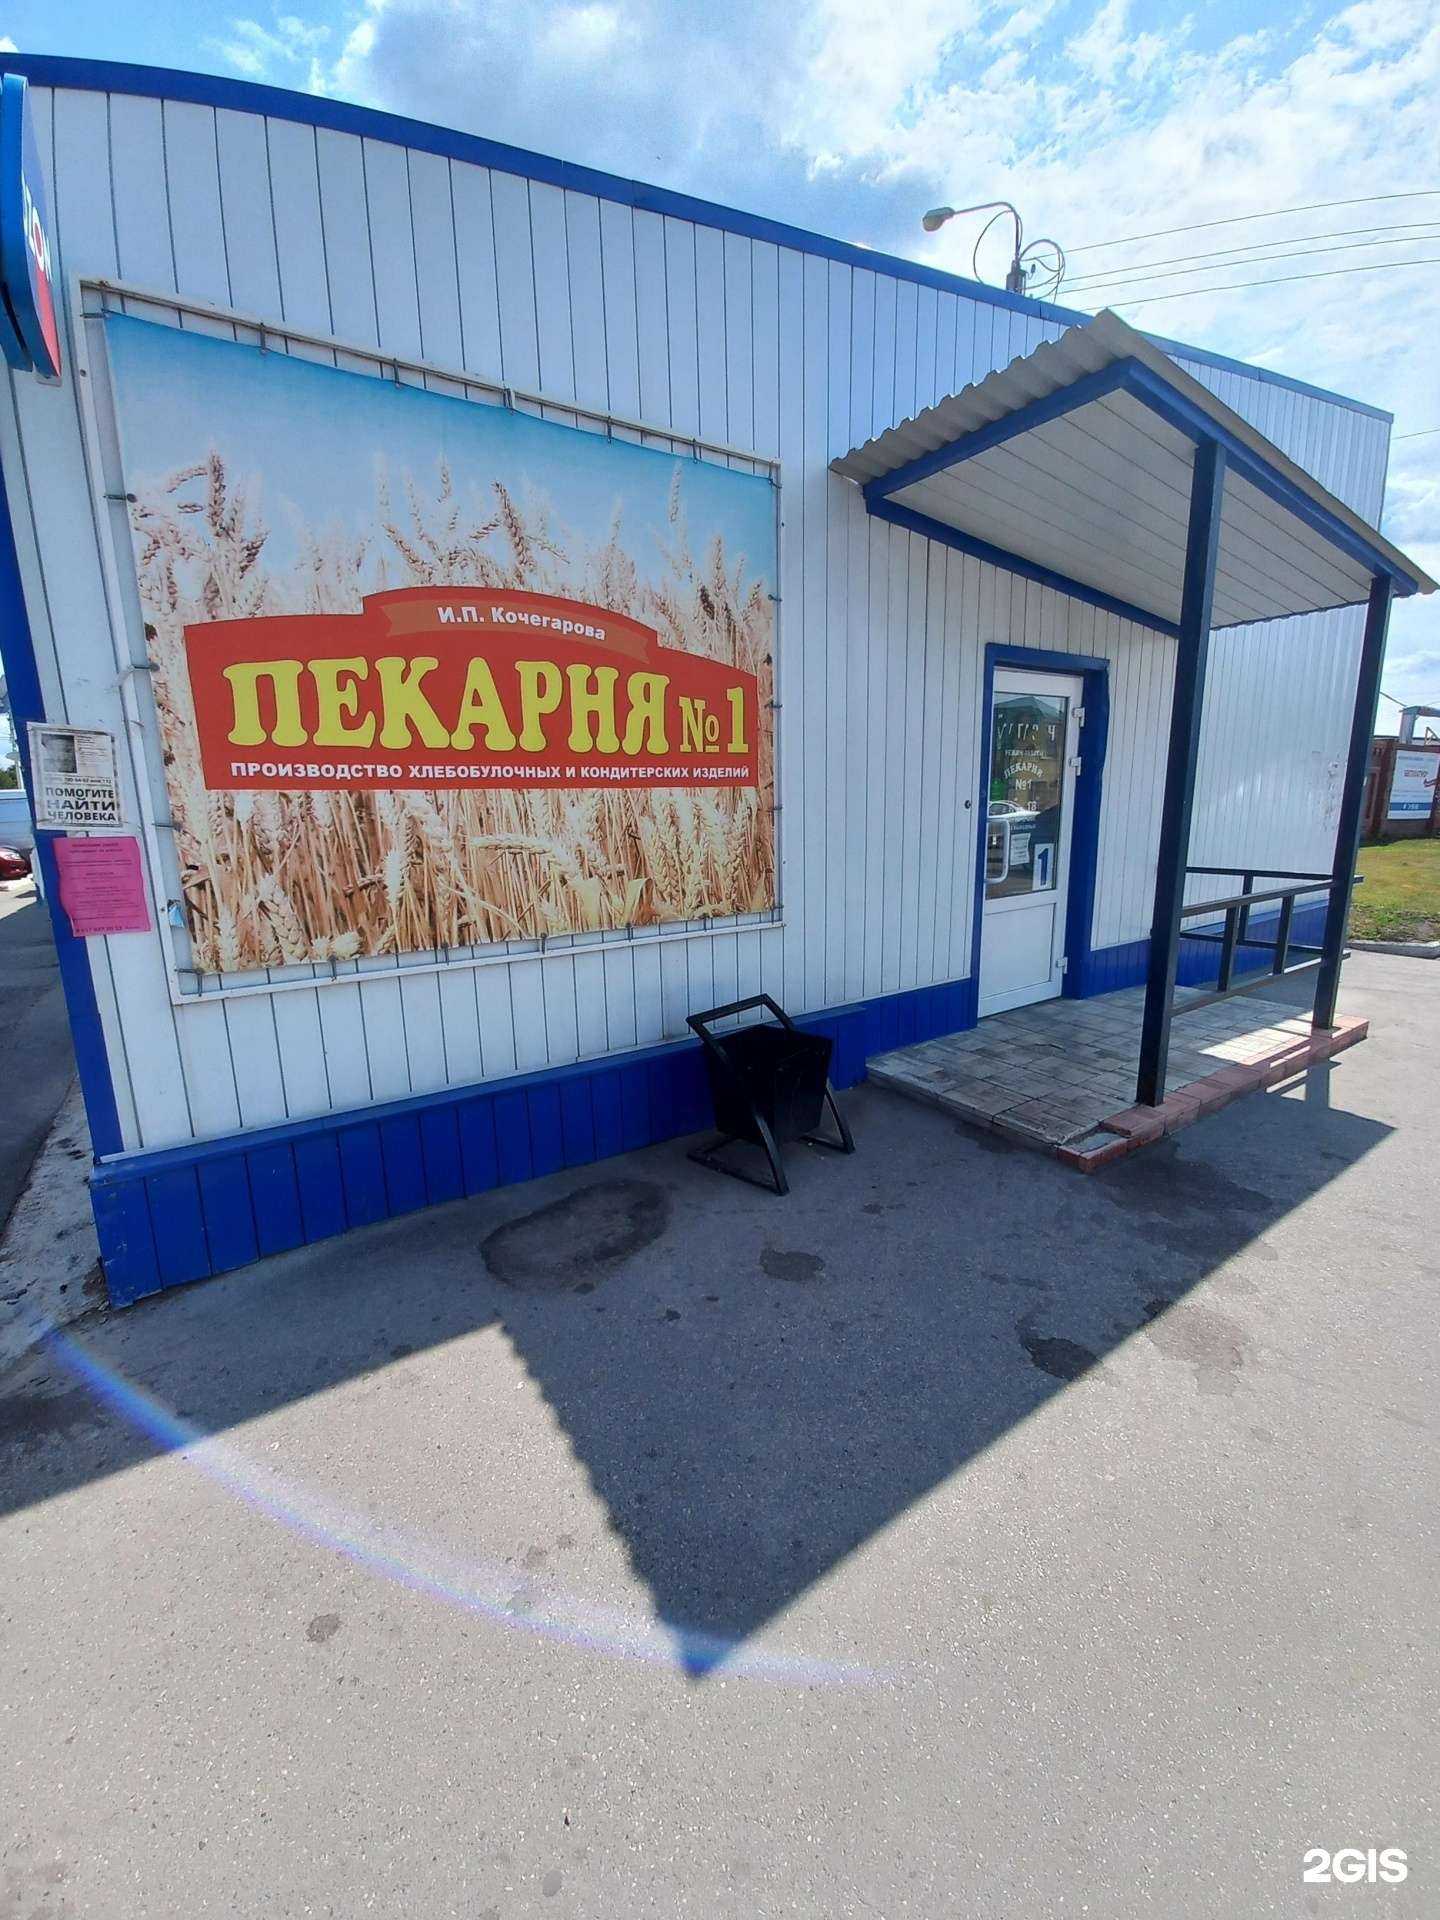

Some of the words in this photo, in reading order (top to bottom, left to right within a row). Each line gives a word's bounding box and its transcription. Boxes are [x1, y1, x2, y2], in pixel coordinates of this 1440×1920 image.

[437, 606, 485, 623] И.П.
[491, 606, 606, 641] Кочегарова
[222, 655, 671, 755] ПЕКАРНЯ
[230, 762, 403, 780] ПРОИЗВОДСТВО
[408, 764, 562, 780] ХЛЕБОБУЛОЧНЫХ
[565, 765, 576, 779] И
[580, 765, 690, 781] КОНДИТЕРСКИХ
[692, 764, 749, 780] ИЗДЕЛИЙ
[45, 786, 115, 799] ПОМОГИТЕ
[46, 797, 116, 811] НАЙТИ
[47, 810, 117, 821] ЧЕЛОВЕКА
